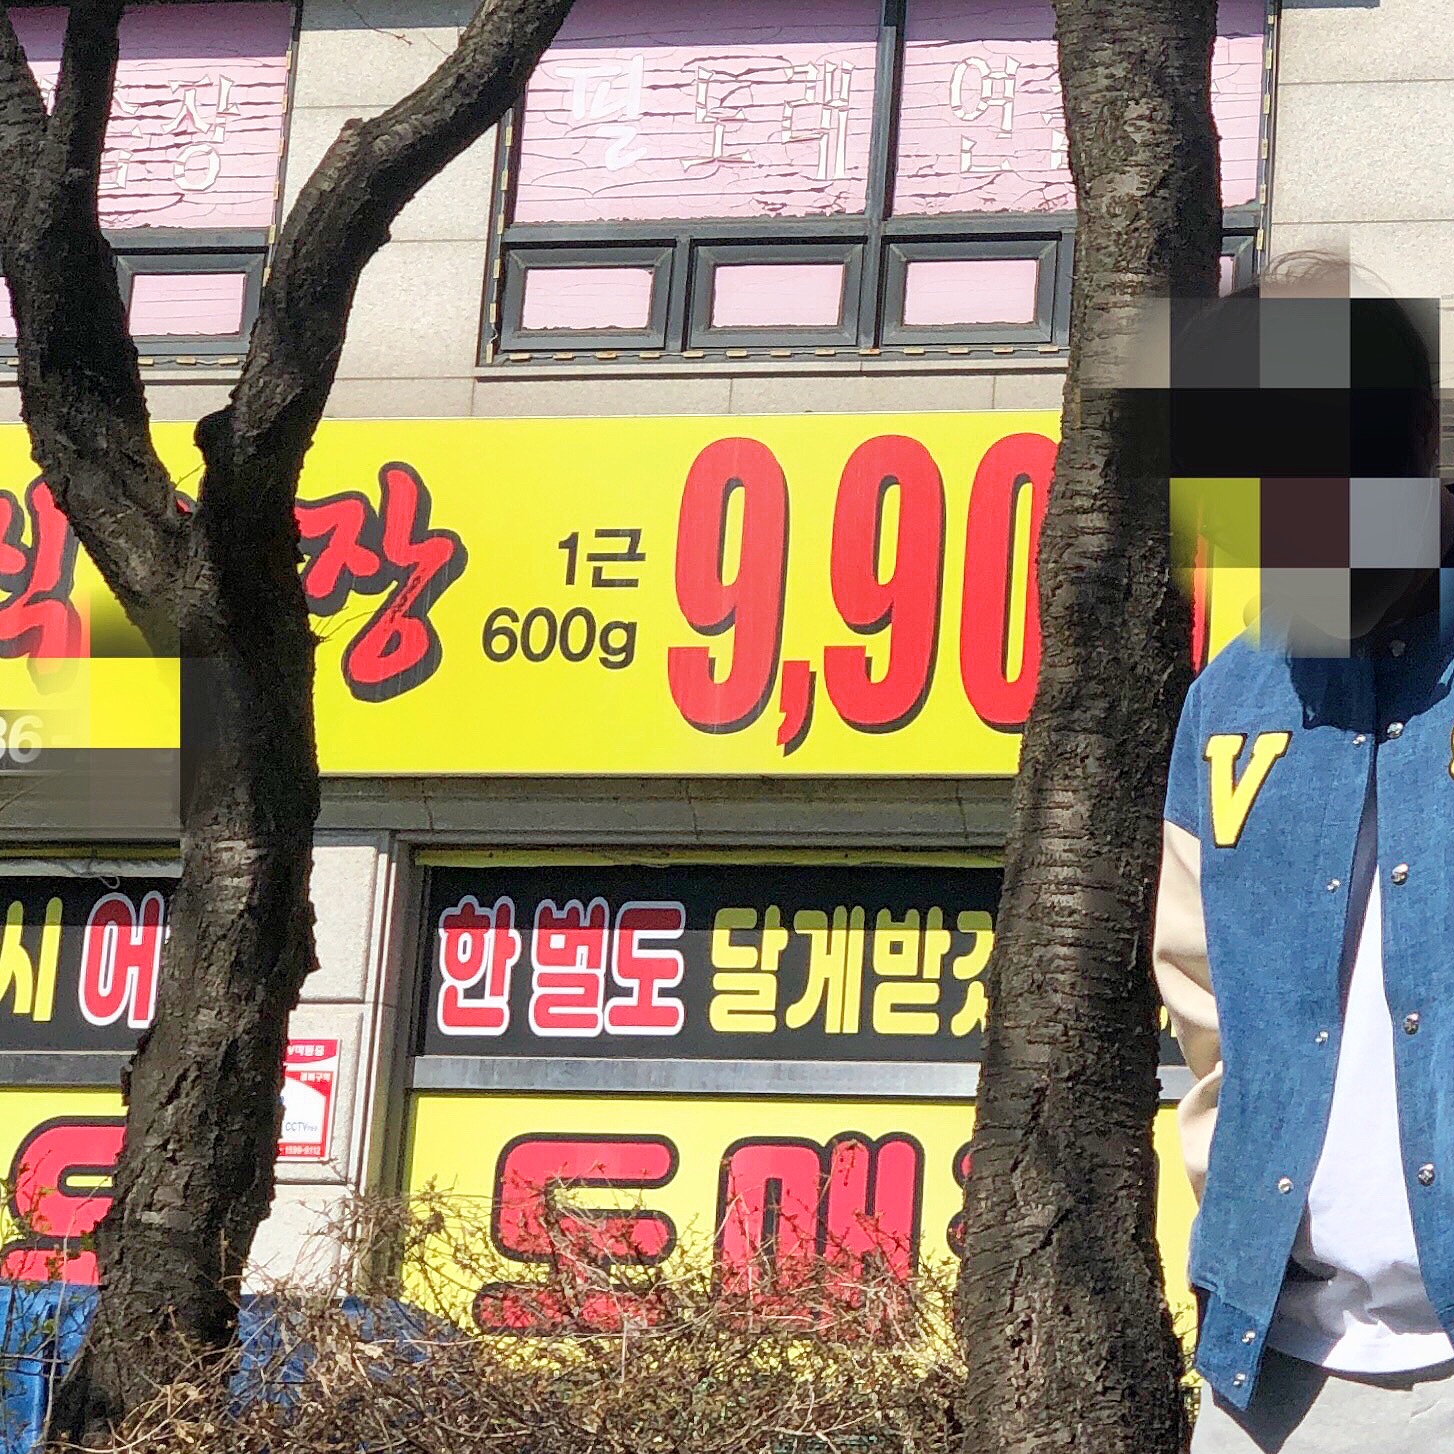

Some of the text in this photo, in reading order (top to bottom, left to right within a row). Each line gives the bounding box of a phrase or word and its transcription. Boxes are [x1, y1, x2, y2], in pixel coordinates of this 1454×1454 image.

[558, 527, 647, 590] 1근
[667, 432, 1060, 757] 9,90
[482, 606, 638, 670] 600g
[1203, 731, 1294, 849] V
[78, 890, 169, 1029] 어
[437, 895, 522, 1038] 한
